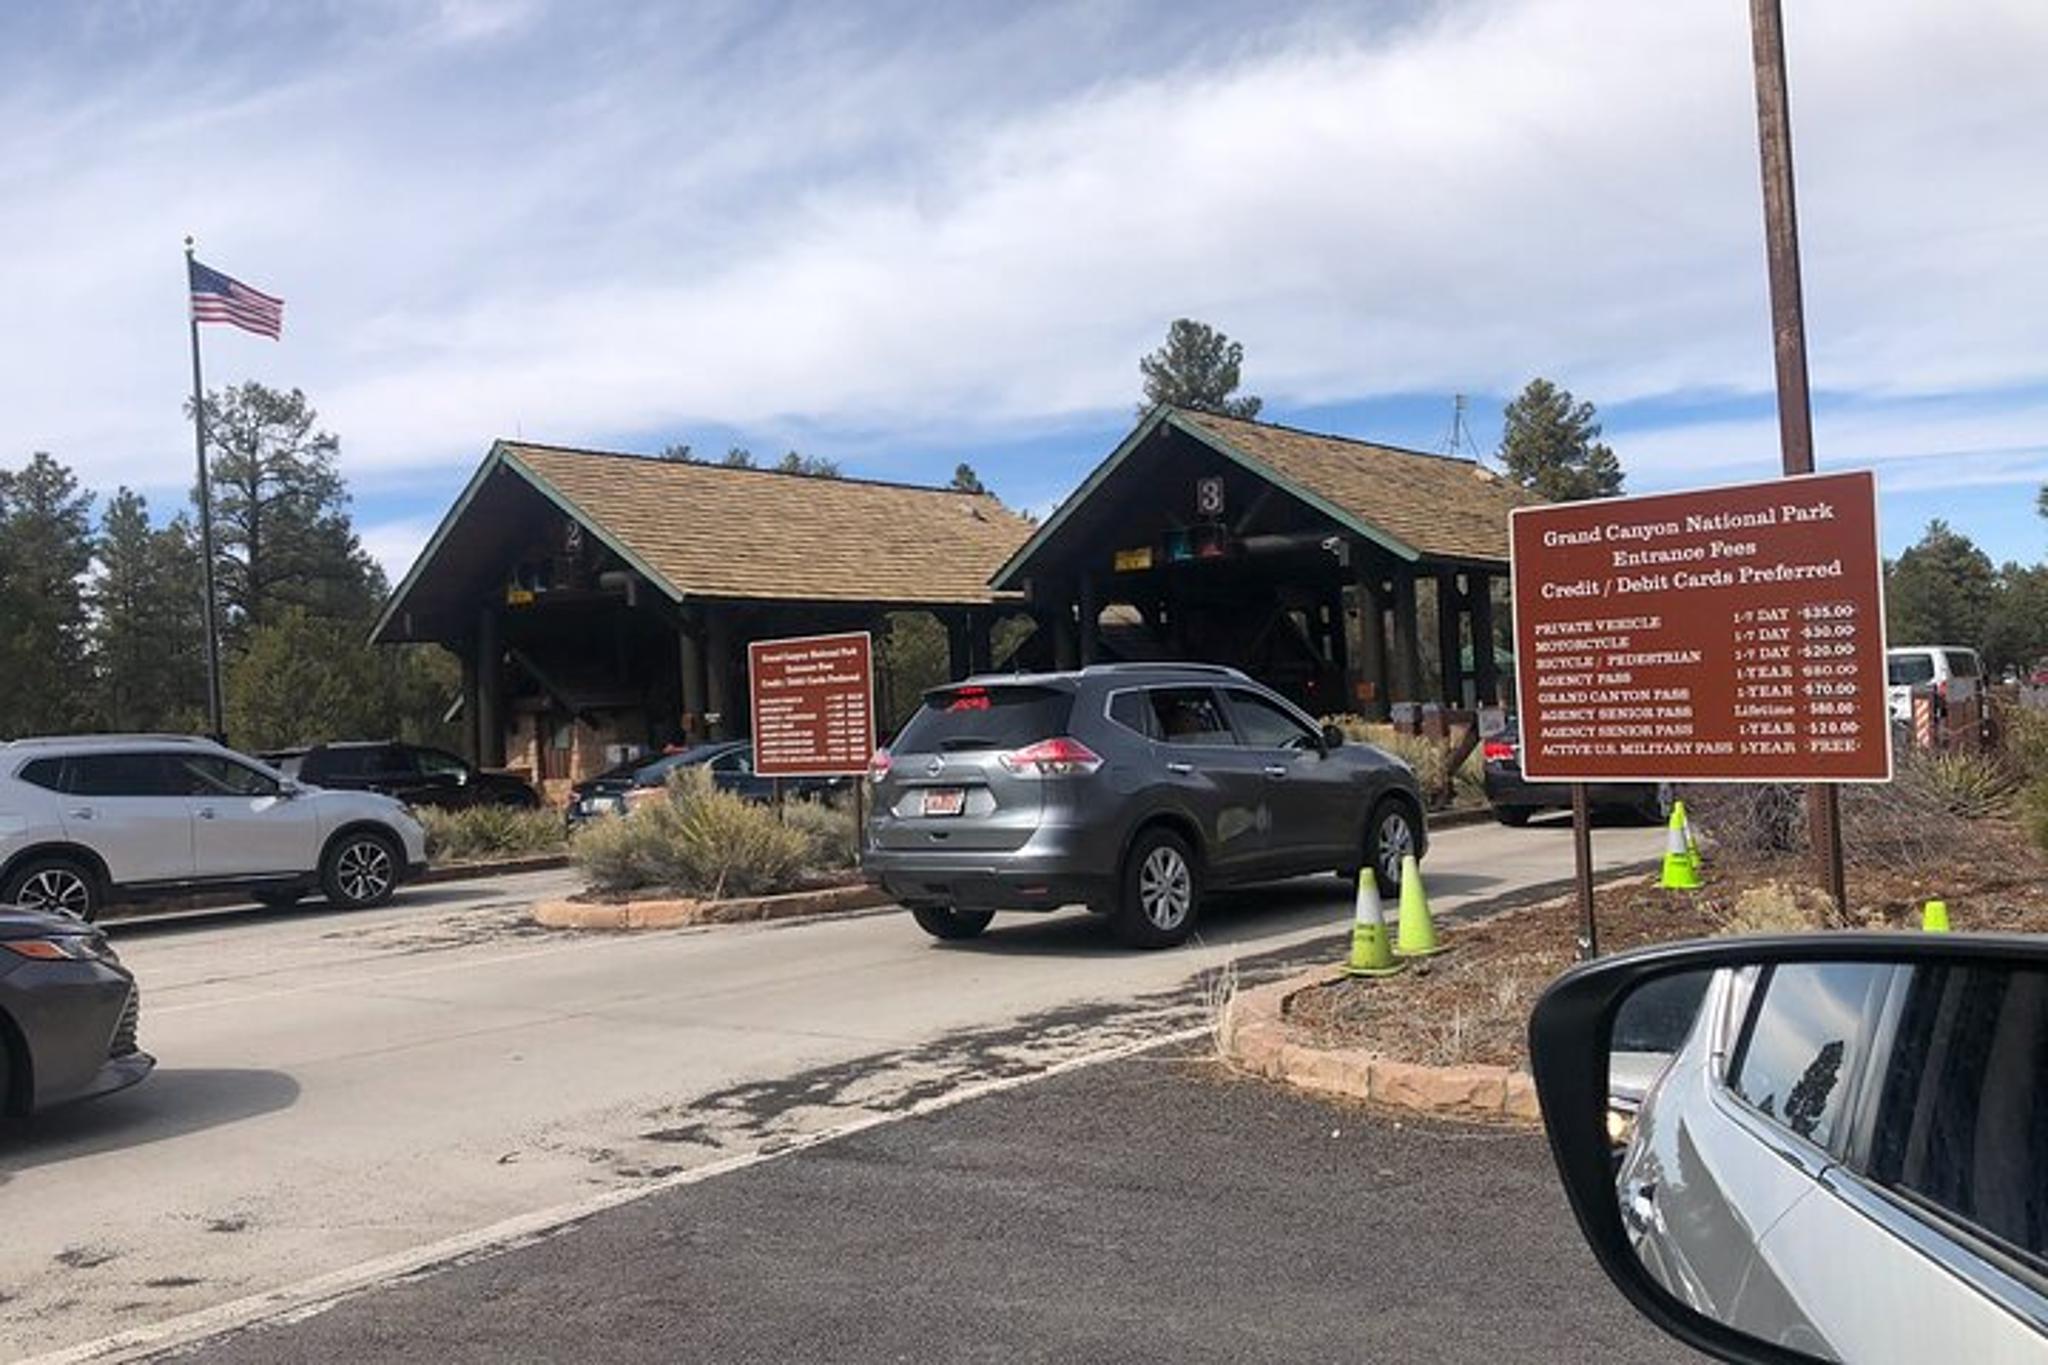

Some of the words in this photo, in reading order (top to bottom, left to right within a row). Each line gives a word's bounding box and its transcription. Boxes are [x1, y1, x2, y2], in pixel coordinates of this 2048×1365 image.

[1202, 482, 1219, 511] 3
[1543, 525, 1601, 547] Grand
[1606, 521, 1680, 545] Canyon
[1686, 507, 1776, 533] National
[1781, 501, 1835, 523] Park
[1612, 546, 1705, 567] Entrance
[1710, 540, 1757, 557] Fees
[1541, 577, 1600, 600] Credit
[1602, 579, 1613, 598] /
[1617, 573, 1669, 595] Debit
[1673, 567, 1733, 589] Cards
[1738, 559, 1844, 585] Preferred
[1535, 620, 1594, 636] PRIVATE
[1596, 616, 1662, 631] VEHICLE
[1757, 608, 1790, 622] DAY
[1535, 636, 1631, 653] MOTORCYCLE
[1759, 628, 1791, 641] DAY
[1535, 656, 1594, 670] BICYCLE
[1606, 650, 1702, 667] PEDESTRIAN
[1759, 647, 1791, 660] DAY
[1538, 674, 1594, 687] AGENCY
[1598, 672, 1632, 685] PASS
[1736, 665, 1794, 680] 1-YEAR
[1538, 692, 1588, 704] GRAND
[1590, 689, 1651, 703] CANYON
[1654, 687, 1691, 700] PASS
[1540, 709, 1596, 722] AGENCY
[1598, 707, 1654, 720] SENIOR
[1656, 705, 1694, 718] PASS
[1734, 704, 1796, 718] Lifetime
[1540, 726, 1596, 739] AGENCY
[1598, 725, 1654, 738] SENIOR
[1655, 723, 1694, 736] PASS
[1541, 744, 1590, 756] ACTIVE
[1620, 742, 1693, 755] MILITARY
[1695, 741, 1734, 755] PASS
[1810, 740, 1857, 754] FREE
